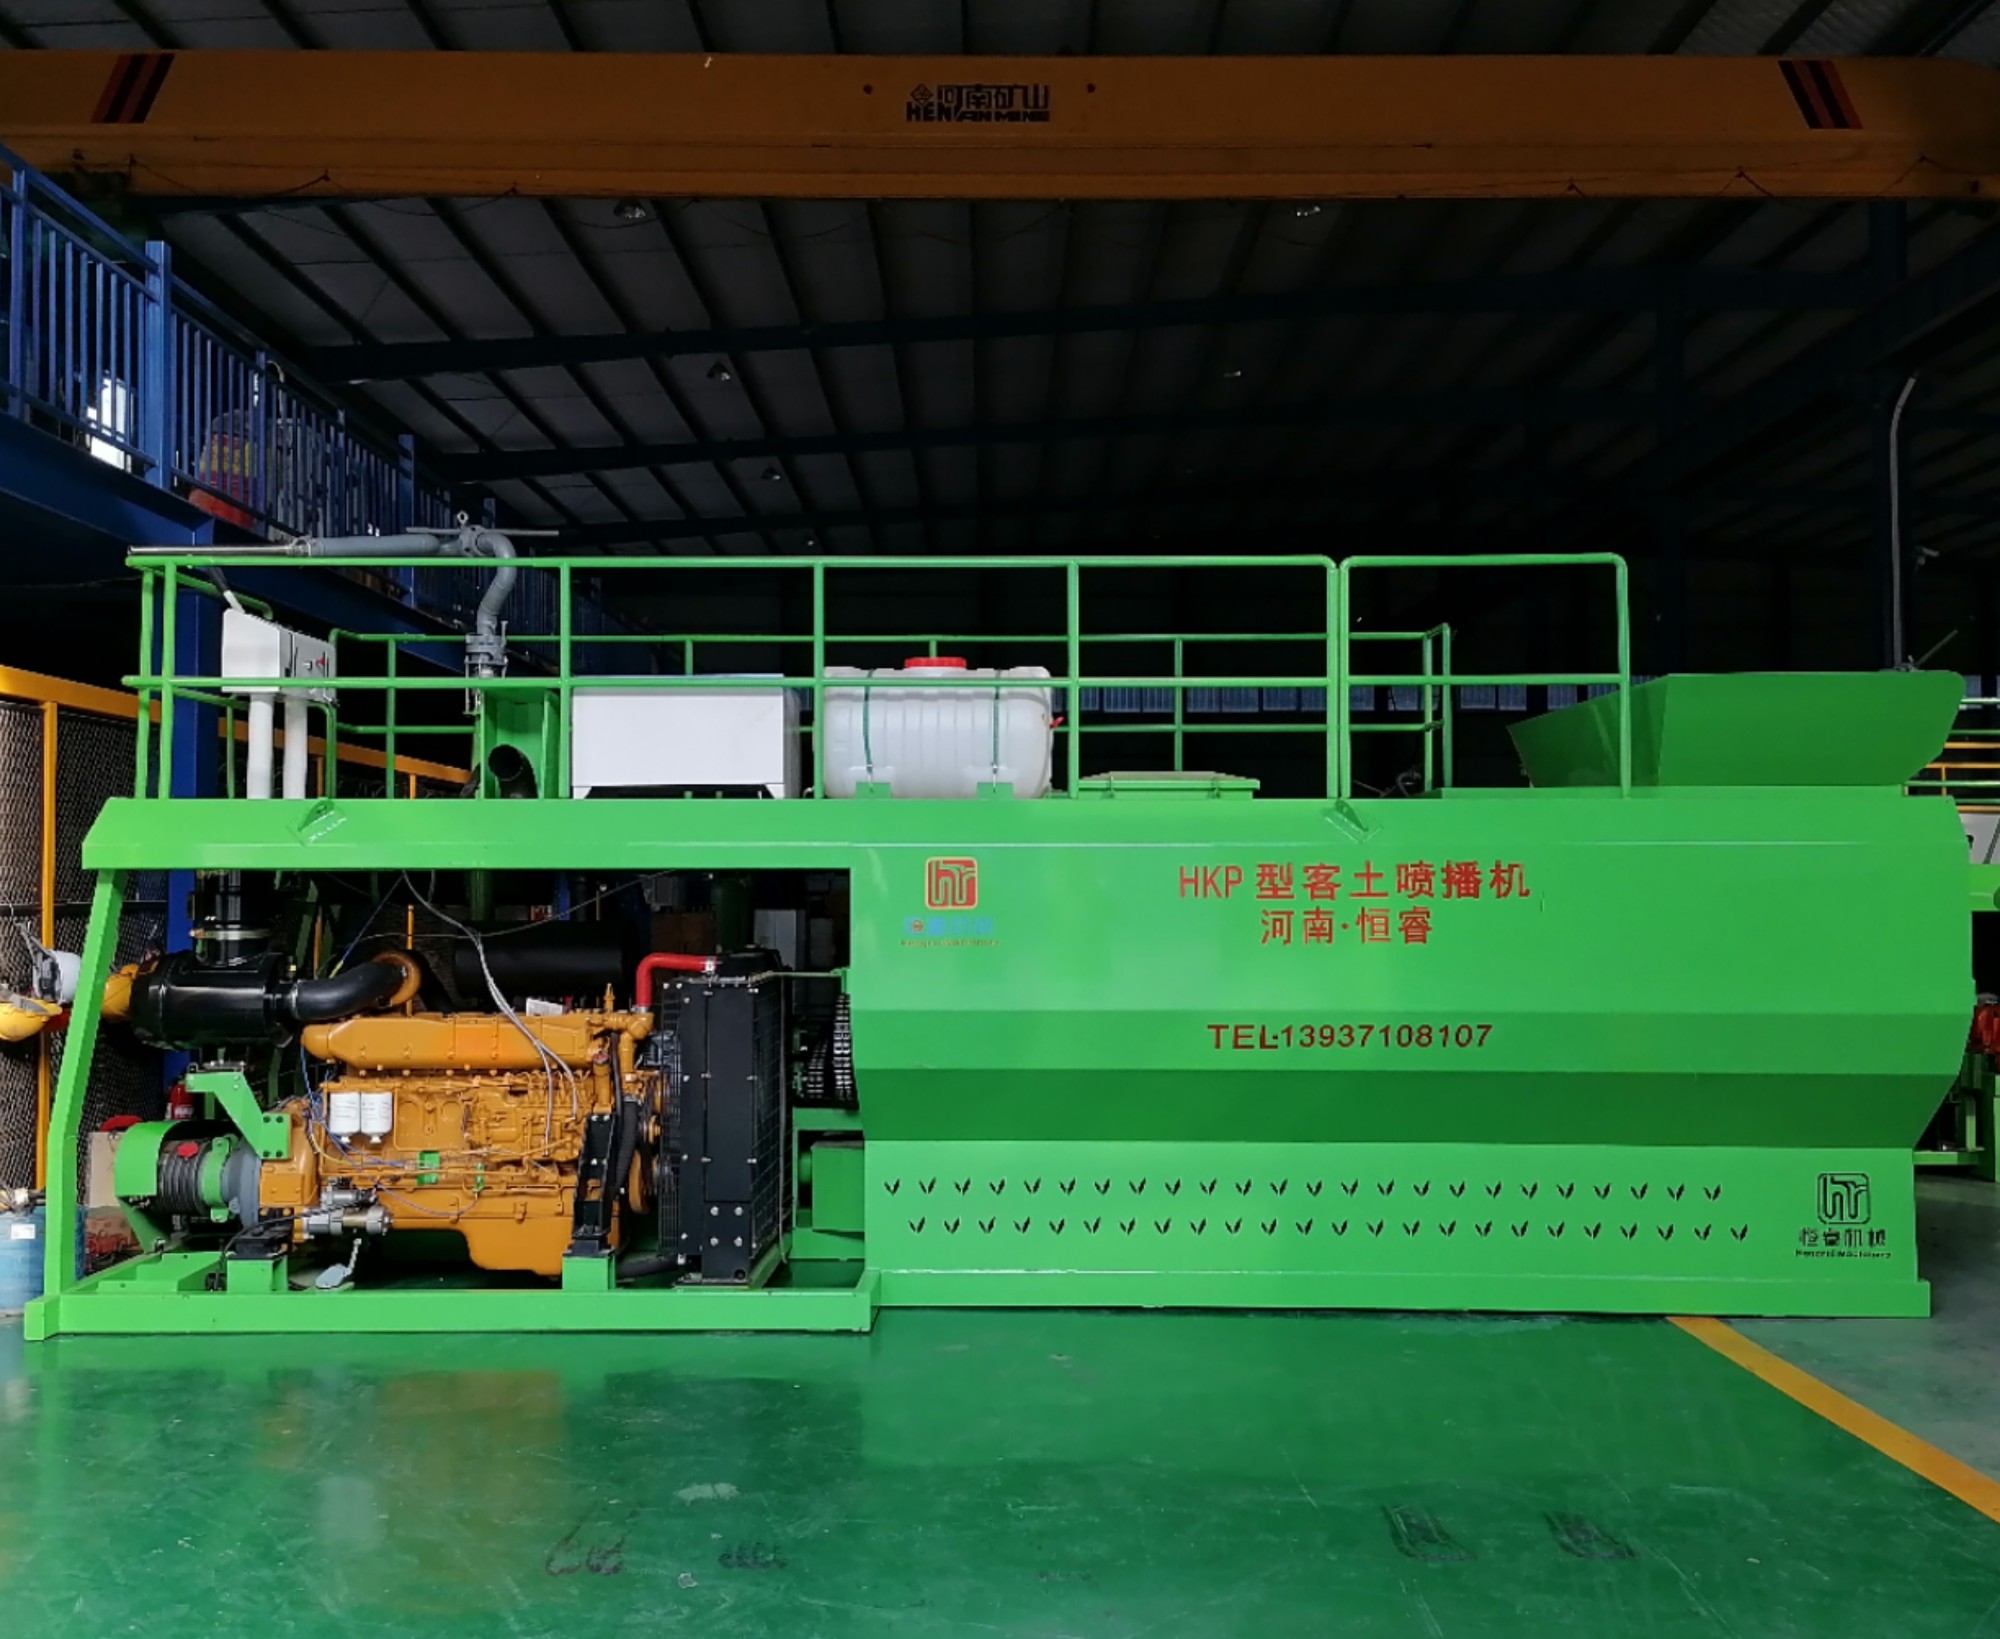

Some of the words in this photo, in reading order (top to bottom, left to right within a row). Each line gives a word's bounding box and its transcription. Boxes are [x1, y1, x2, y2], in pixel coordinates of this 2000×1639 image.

[1179, 865, 1244, 899] HKP
[1255, 861, 1531, 901] 型客土喷播机
